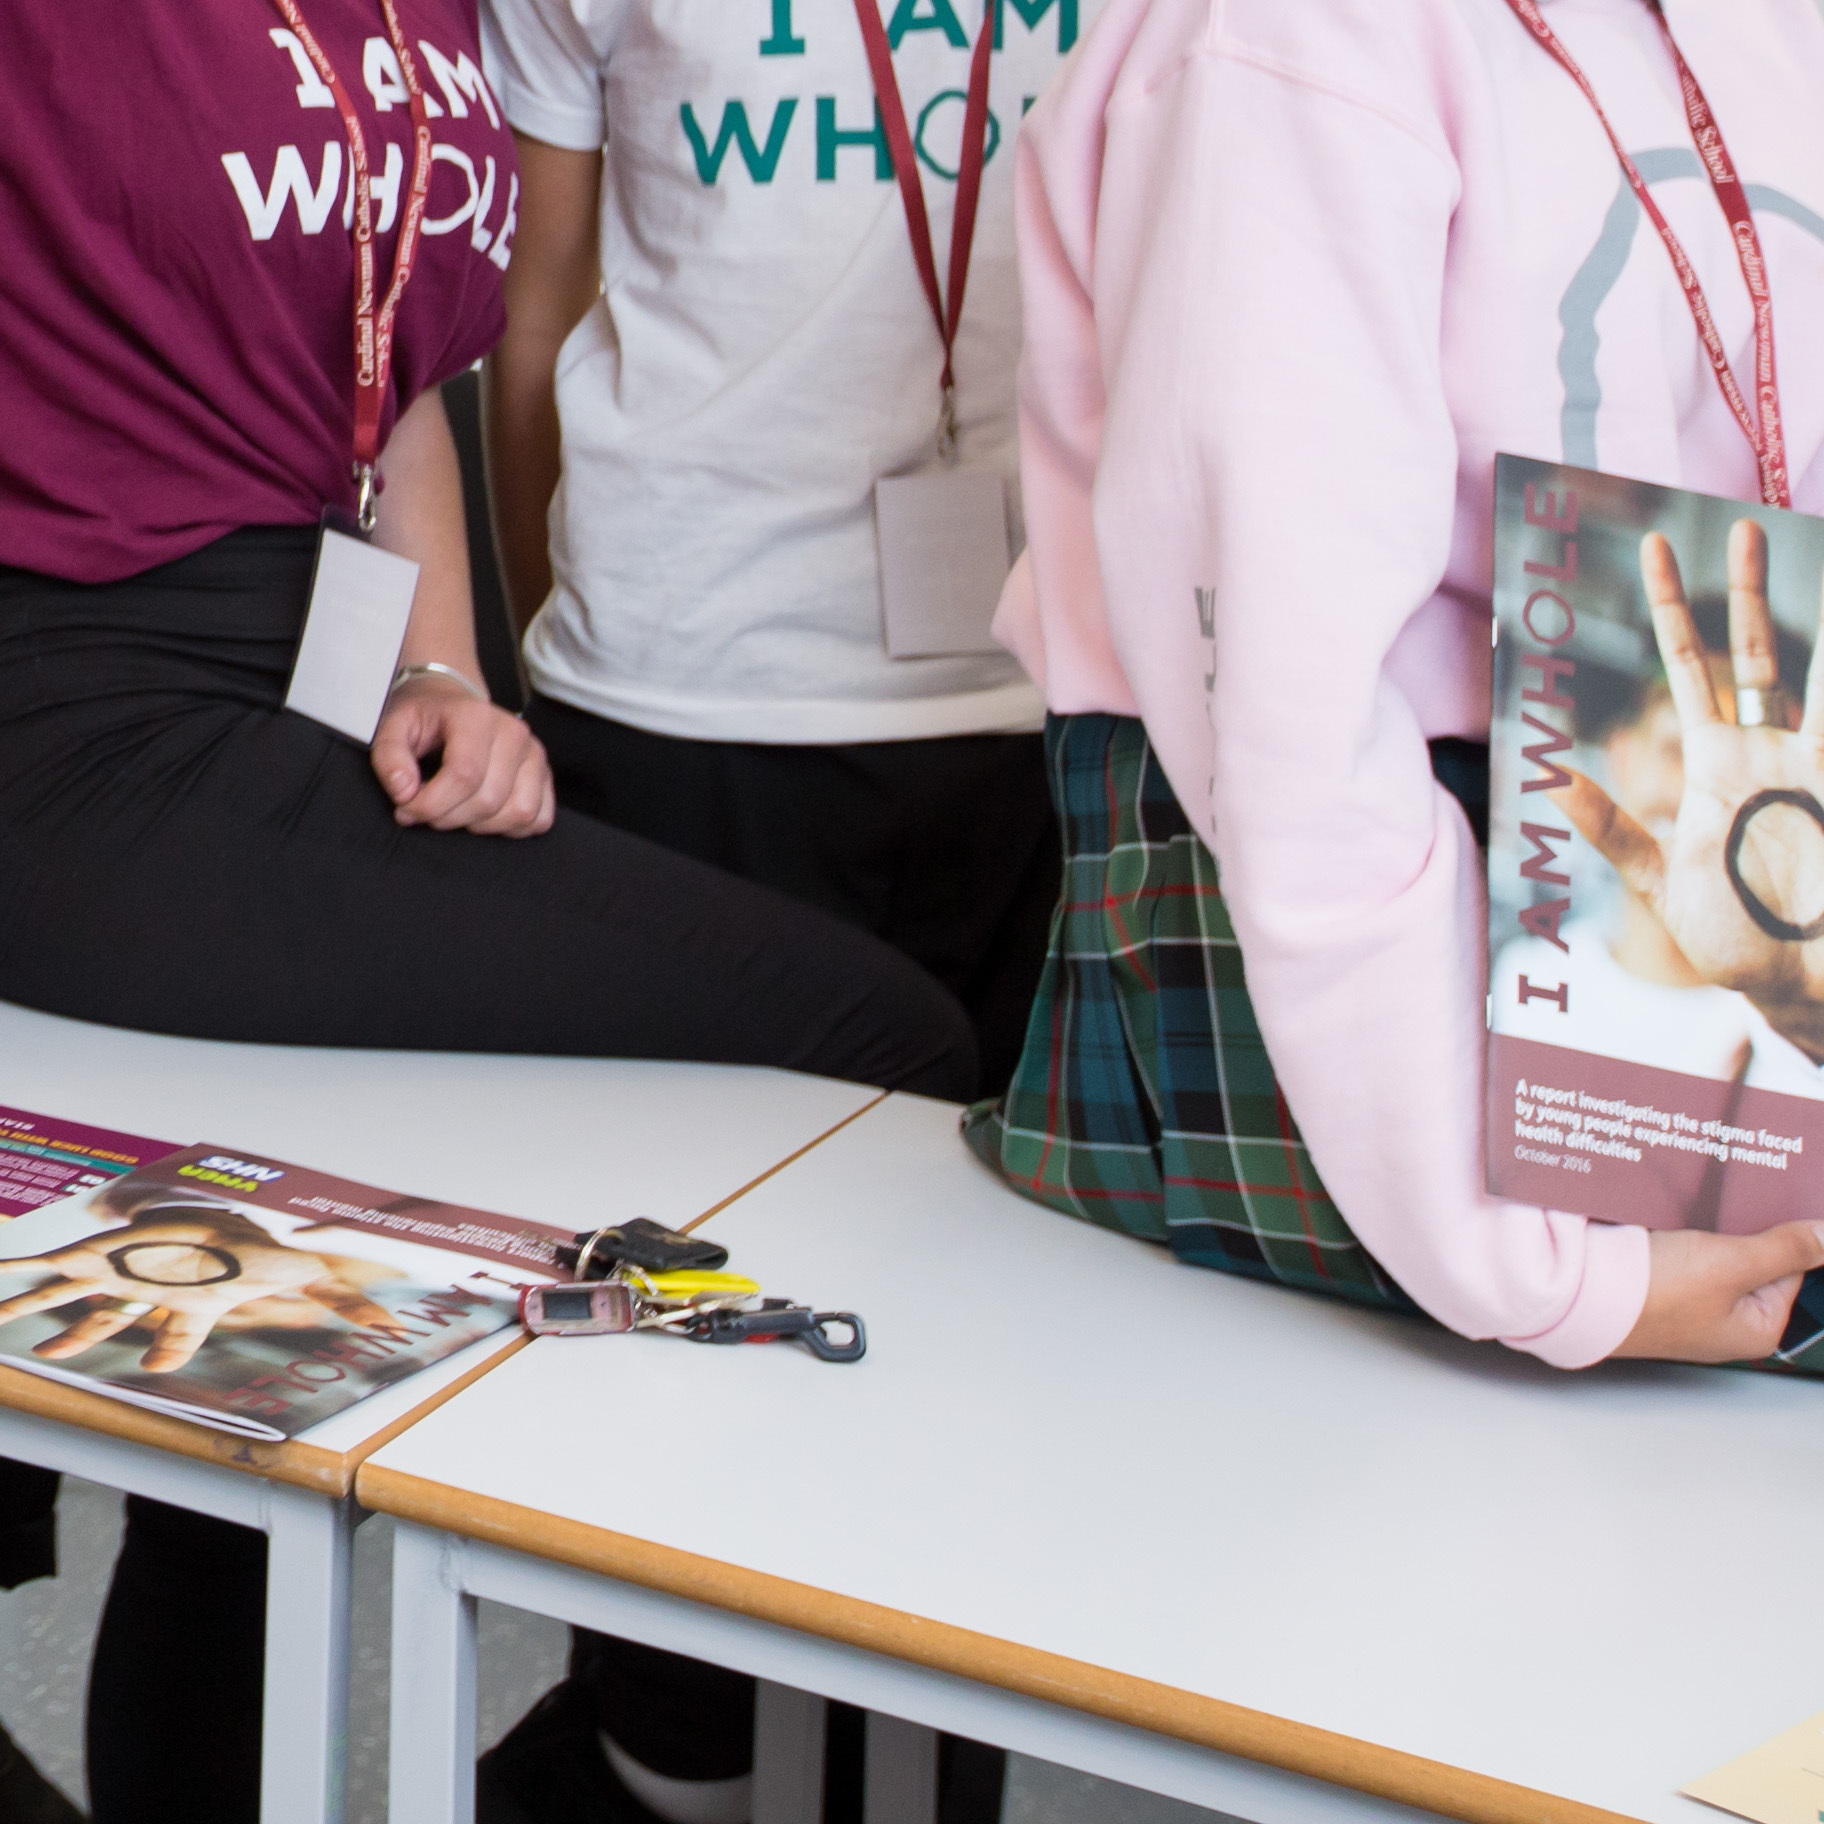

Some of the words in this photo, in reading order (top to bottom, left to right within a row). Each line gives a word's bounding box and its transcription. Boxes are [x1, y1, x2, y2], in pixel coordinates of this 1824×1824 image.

[269, 28, 335, 108] I
[362, 36, 500, 130] AM
[220, 141, 519, 272] WHOLE
[357, 243, 374, 316] Newman
[357, 316, 374, 387] Cardinal
[1520, 481, 1581, 794] WHOLE
[1518, 820, 1571, 955] AM
[1518, 974, 1569, 1013] I
[1514, 1119, 1564, 1145] health
[1565, 1130, 1642, 1163] difficulties
[1515, 1078, 1529, 1097] A
[1530, 1084, 1578, 1108] report
[1578, 1090, 1671, 1130] investigating
[1672, 1112, 1699, 1134] the
[1700, 1120, 1755, 1144] stigma
[1757, 1129, 1803, 1155] faced
[1515, 1096, 1535, 1121] by
[1536, 1104, 1583, 1129] young
[1583, 1114, 1632, 1141] people
[1633, 1125, 1730, 1163] experiencing
[1730, 1147, 1788, 1171] mental
[199, 1155, 284, 1182] NHS
[1514, 1144, 1561, 1167] October
[1562, 1155, 1593, 1175] 2016
[396, 1284, 493, 1327] AM
[224, 1323, 432, 1416] WHOLE
